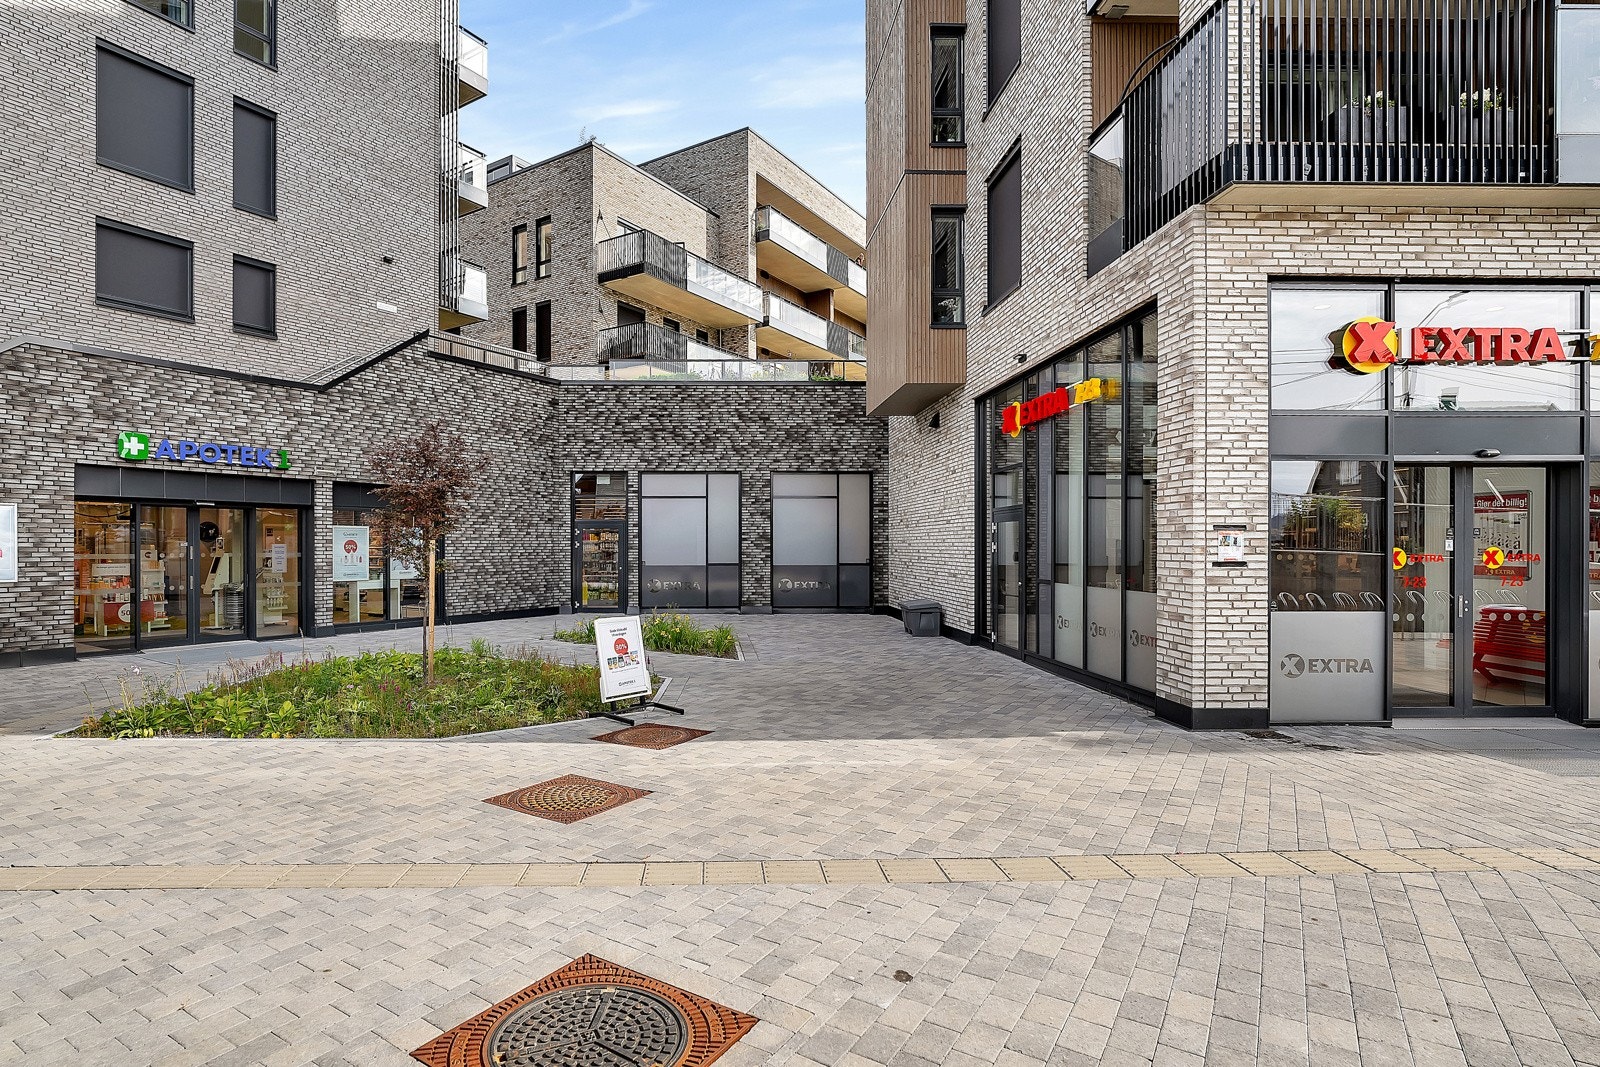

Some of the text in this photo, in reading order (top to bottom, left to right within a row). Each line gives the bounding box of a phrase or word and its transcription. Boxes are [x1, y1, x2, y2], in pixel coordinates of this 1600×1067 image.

[1411, 327, 1567, 362] EXTRA
[1020, 387, 1070, 426] EXTRA
[154, 438, 292, 470] APOTEK 1
[1492, 499, 1504, 507] det
[1505, 497, 1528, 508] billig!
[1410, 554, 1444, 563] EXTRA
[1507, 554, 1541, 563] EXTRA
[1403, 576, 1427, 588] 7-23
[1500, 575, 1524, 587] 7-23
[1308, 659, 1374, 674] EXTRA
